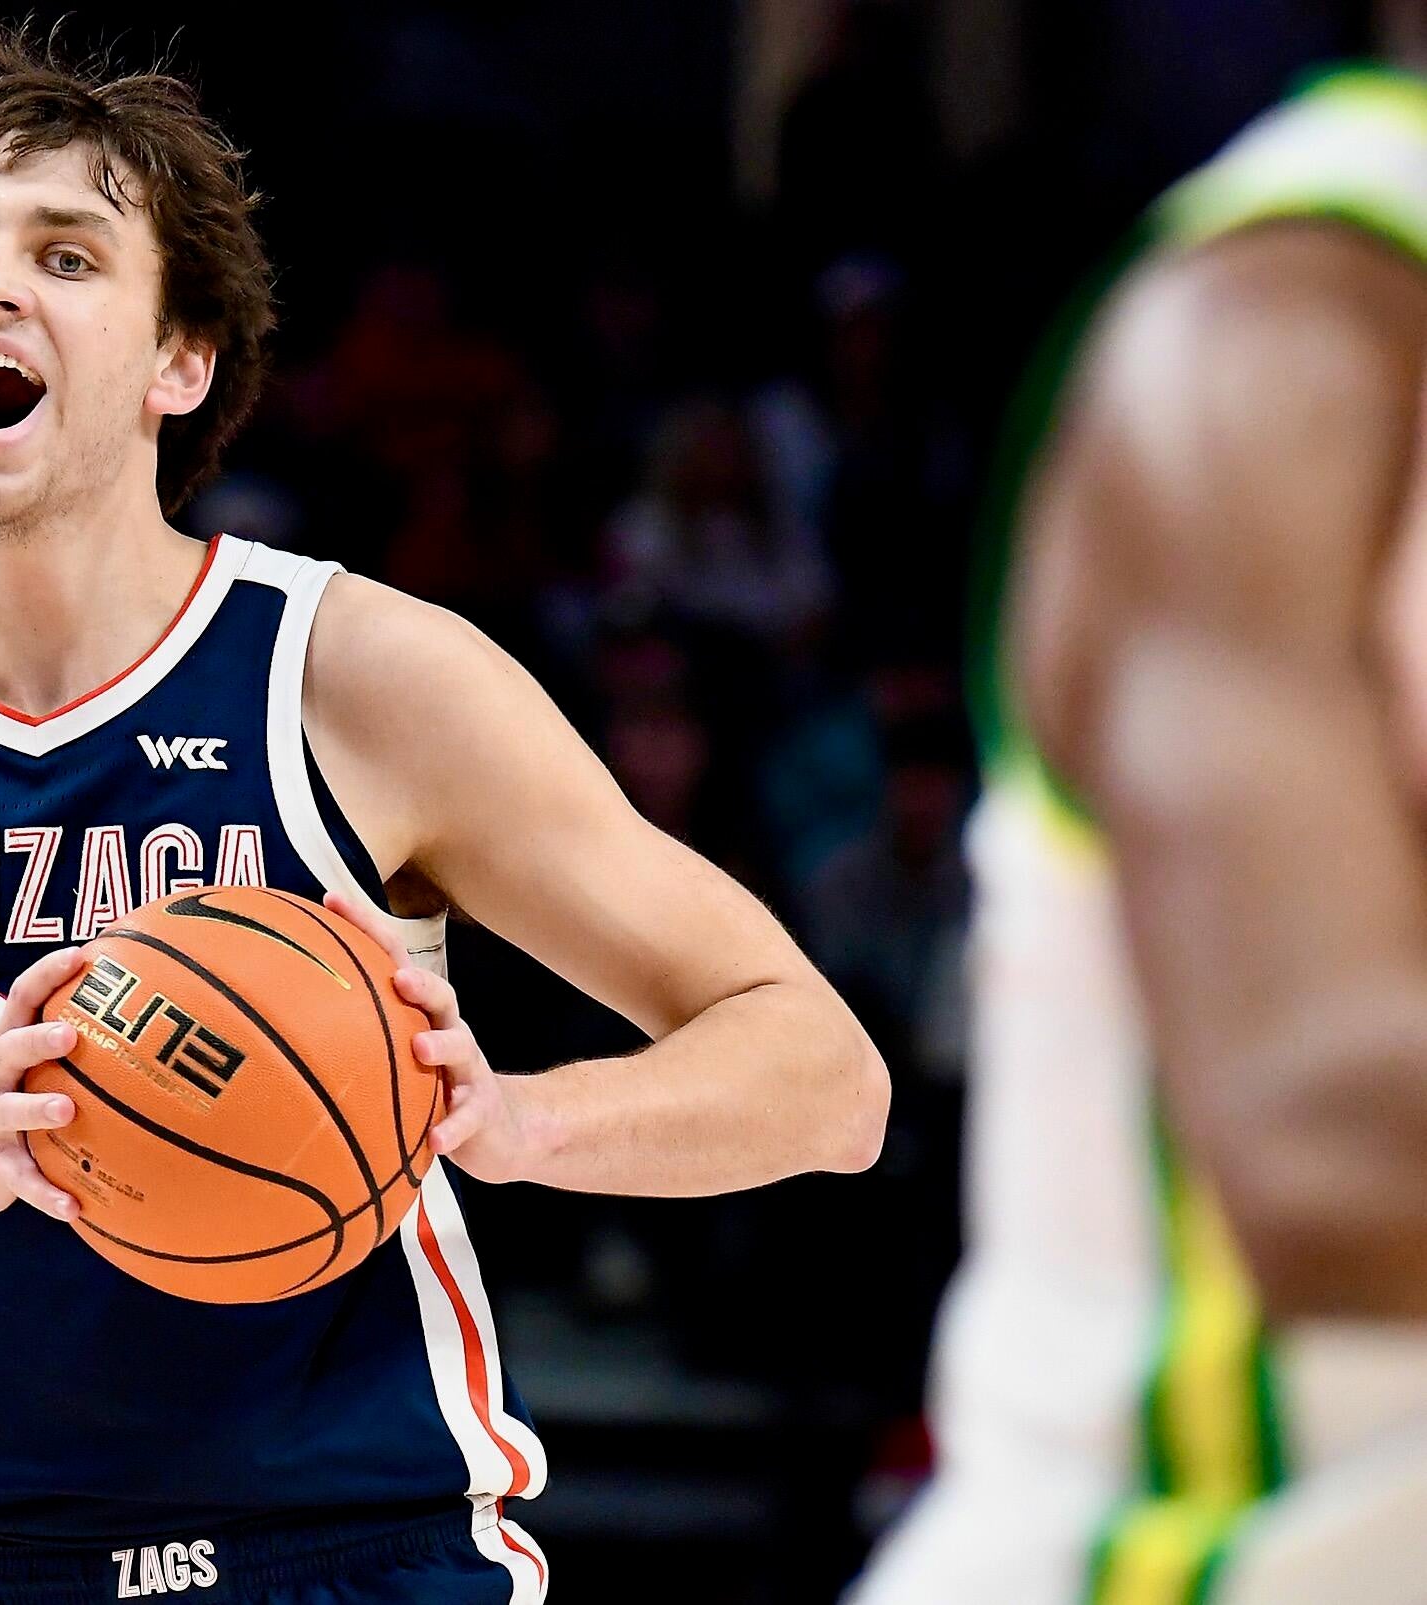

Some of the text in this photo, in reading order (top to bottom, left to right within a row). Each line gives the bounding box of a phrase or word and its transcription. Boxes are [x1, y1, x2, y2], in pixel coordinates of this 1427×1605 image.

[136, 734, 228, 770] WCC
[58, 1008, 212, 1114] CHAMPION
[69, 954, 247, 1100] ELITE
[111, 1539, 219, 1599] ZAGS
